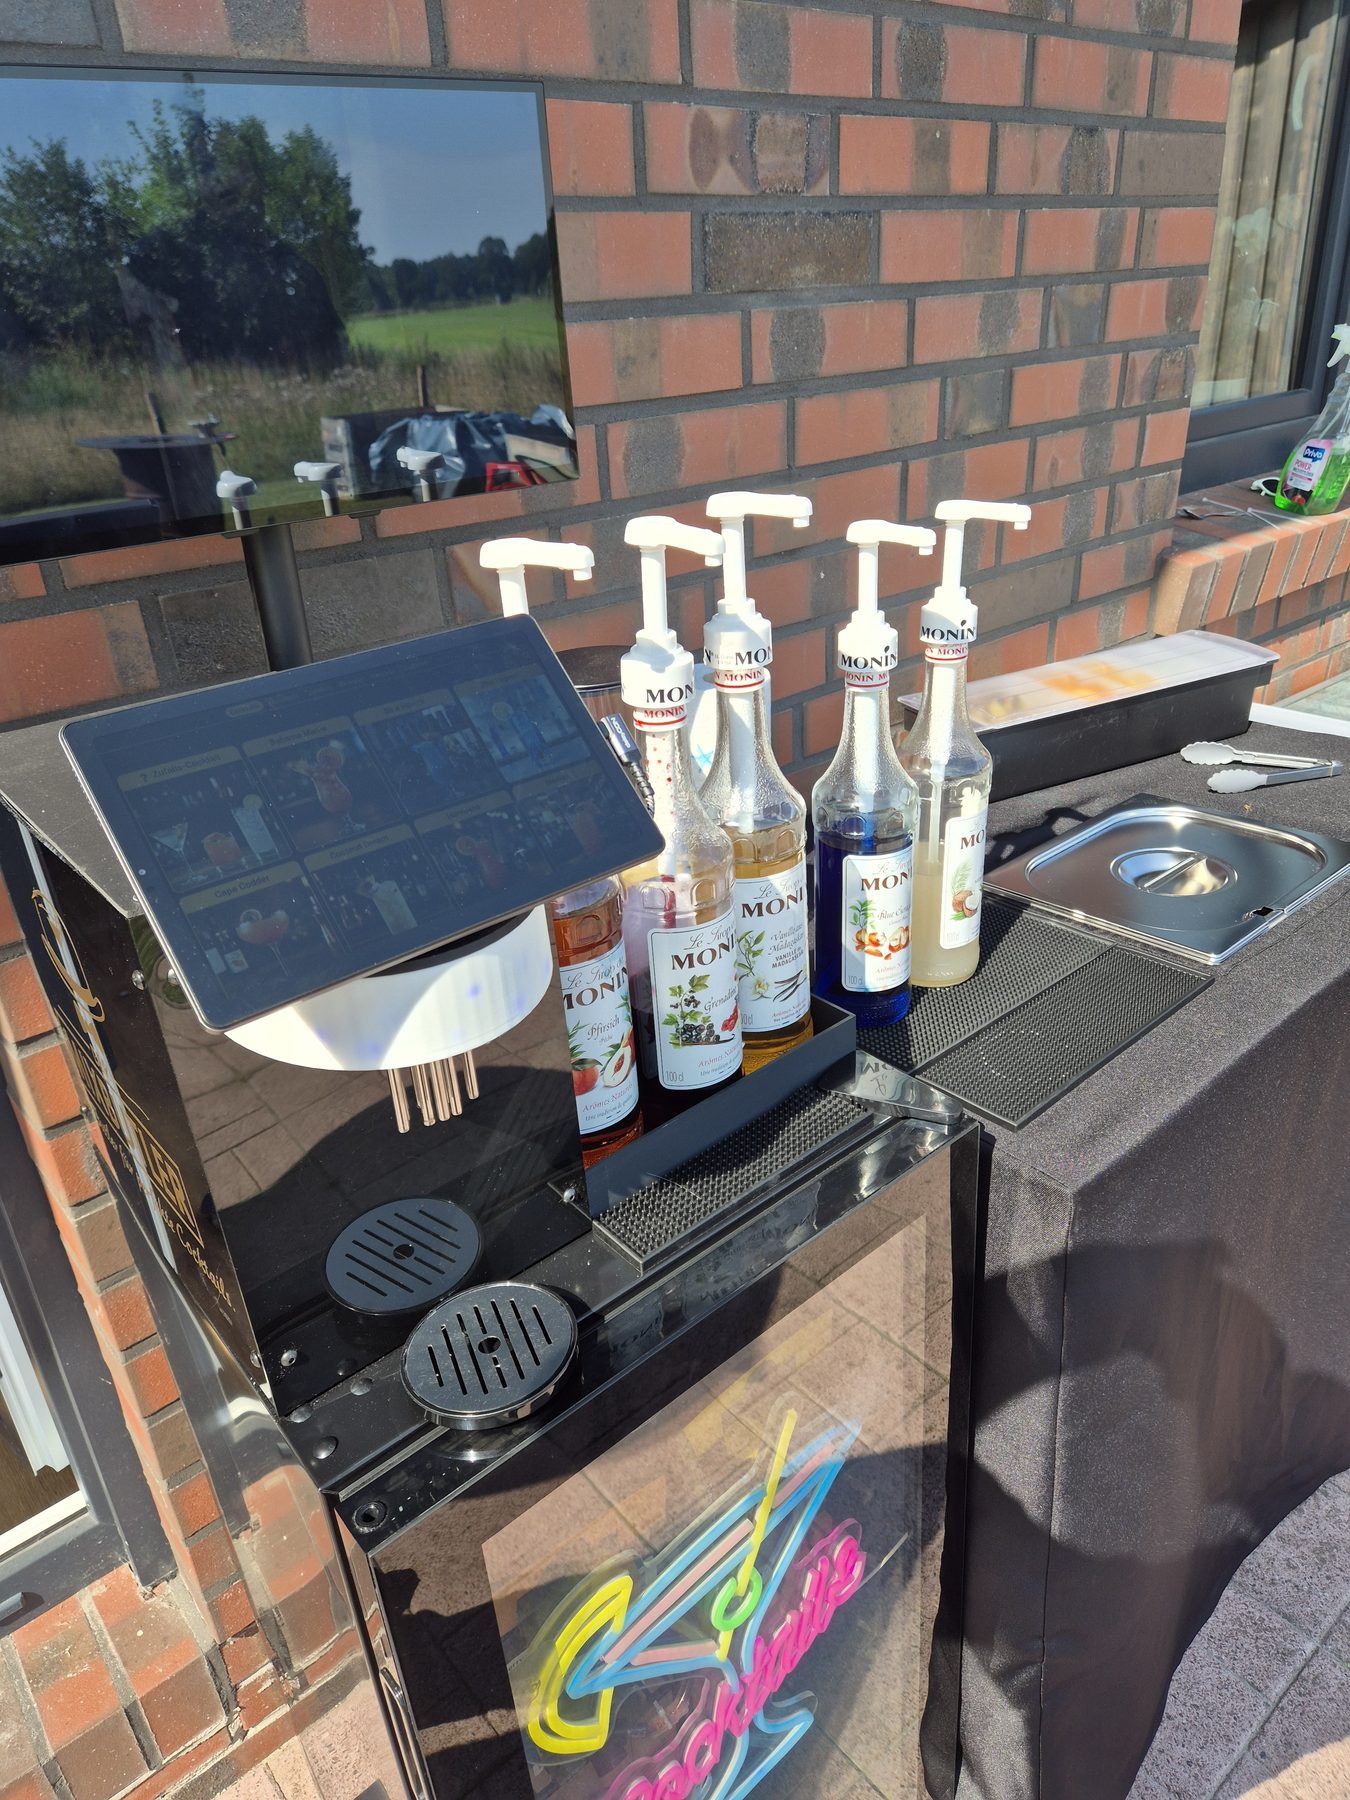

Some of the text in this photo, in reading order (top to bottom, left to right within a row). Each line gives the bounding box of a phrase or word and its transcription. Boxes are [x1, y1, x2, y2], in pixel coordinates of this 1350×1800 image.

[921, 623, 977, 641] MONIN
[724, 671, 762, 682] MONIN
[644, 703, 685, 719] MONIN
